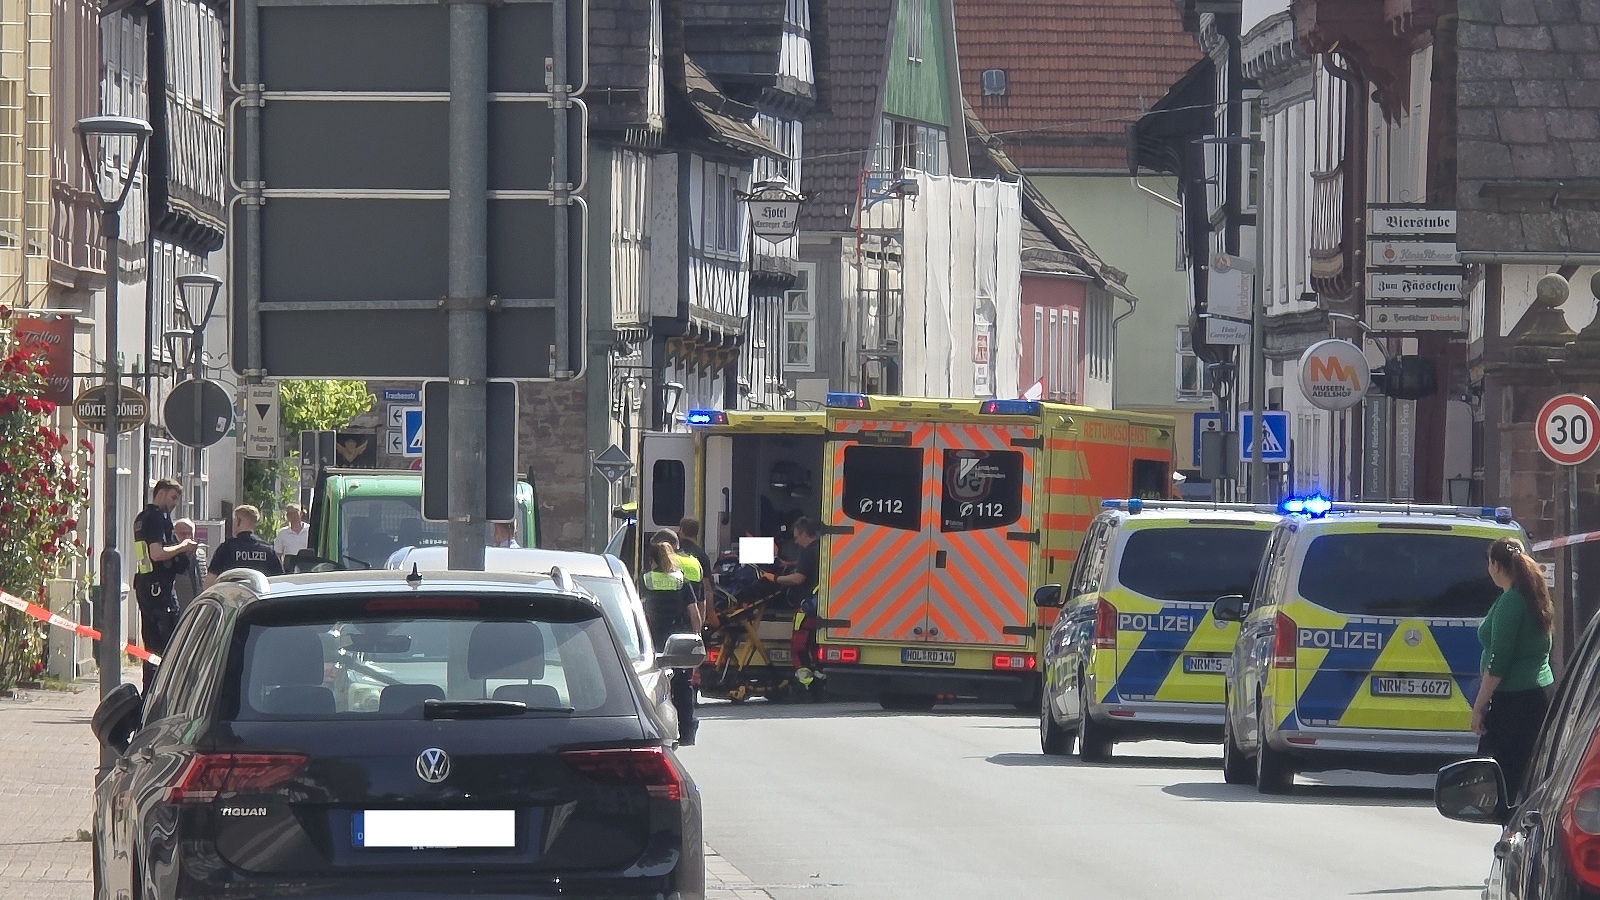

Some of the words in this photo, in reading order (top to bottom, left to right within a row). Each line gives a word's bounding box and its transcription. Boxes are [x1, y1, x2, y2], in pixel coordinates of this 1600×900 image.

[762, 207, 787, 219] Hotel
[1386, 215, 1451, 228] Bierstube
[1378, 281, 1398, 291] Zum
[1402, 280, 1456, 293] Fässchen
[78, 402, 107, 417] HÖXTE
[1083, 420, 1149, 443] RETTUNGSDIENST
[1551, 415, 1588, 445] 30
[1400, 427, 1411, 458] Jacob
[1400, 459, 1410, 492] Forum
[876, 499, 903, 513] 112
[976, 502, 1004, 517] 112
[235, 551, 267, 561] POLIZEI
[1119, 614, 1194, 632] POLIZEI
[1299, 629, 1383, 650] POLIZEI
[906, 650, 922, 661] HOL
[927, 651, 938, 661] RD
[939, 651, 955, 662] 144
[1190, 658, 1210, 670] NRW
[1379, 679, 1402, 693] NRW
[1407, 680, 1450, 694] 5-6677
[220, 806, 267, 816] TIGUAN
